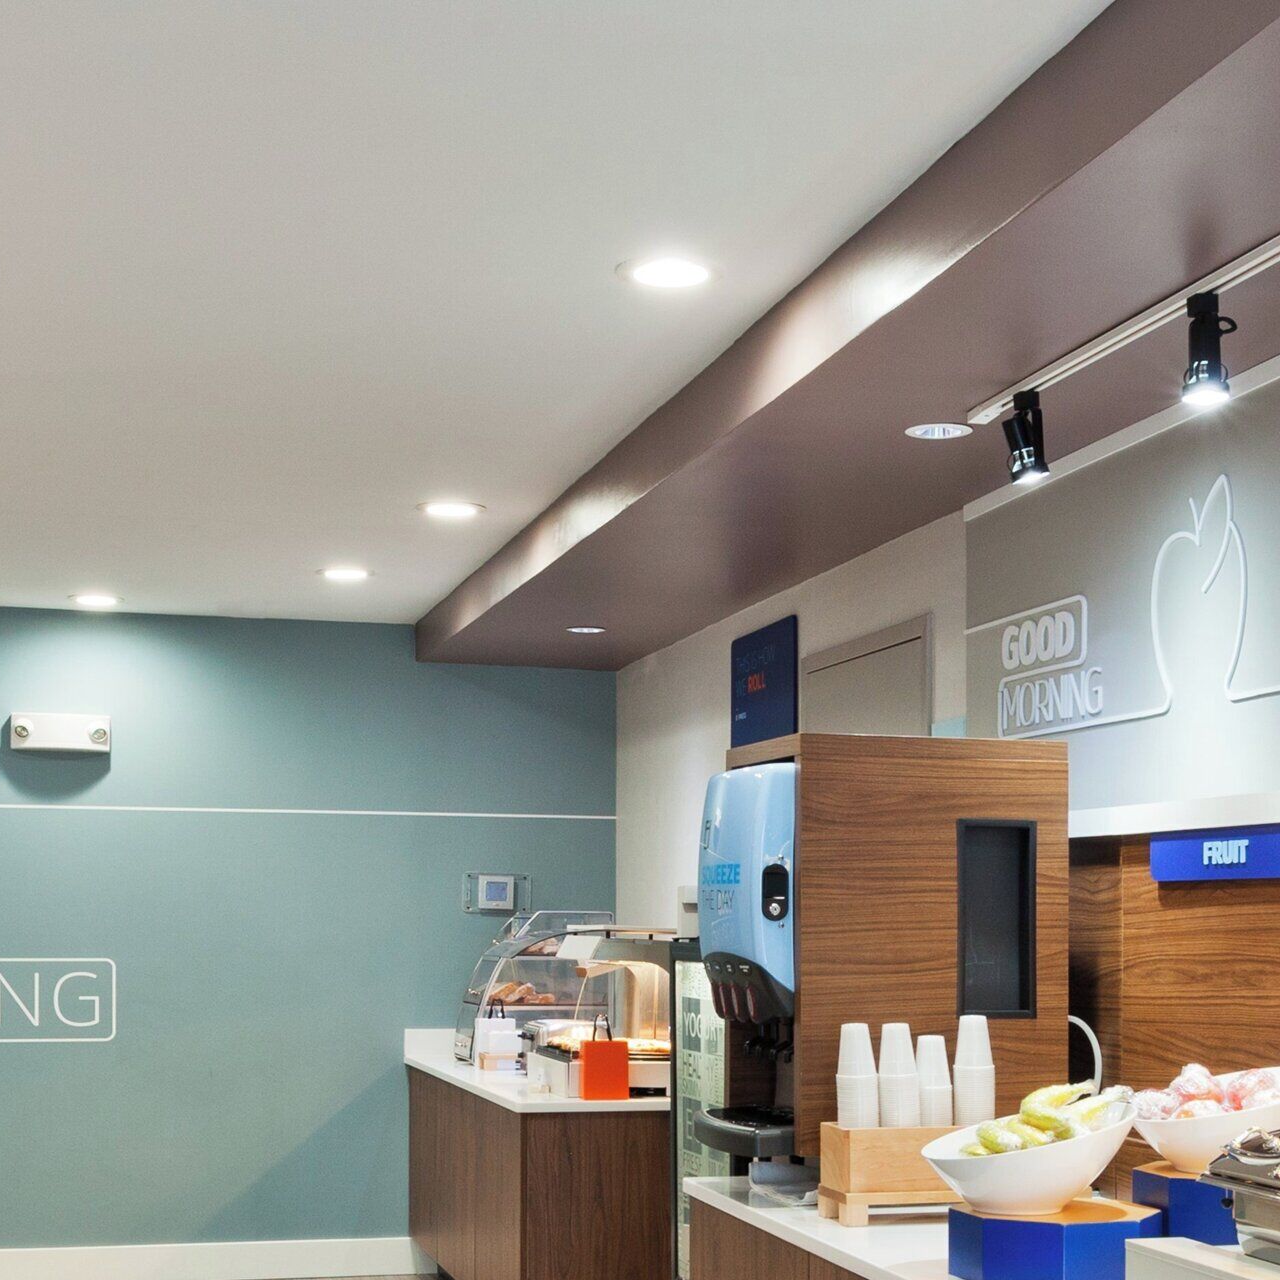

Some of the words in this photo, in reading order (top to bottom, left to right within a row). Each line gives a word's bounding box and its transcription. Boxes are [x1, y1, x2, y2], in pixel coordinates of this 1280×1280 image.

[1002, 610, 1075, 670] GOOD
[747, 671, 767, 695] ROLL
[1003, 667, 1103, 730] MORNING
[1202, 839, 1250, 865] FRUIT
[701, 863, 740, 886] SQUEEZE
[716, 889, 735, 911] DAY
